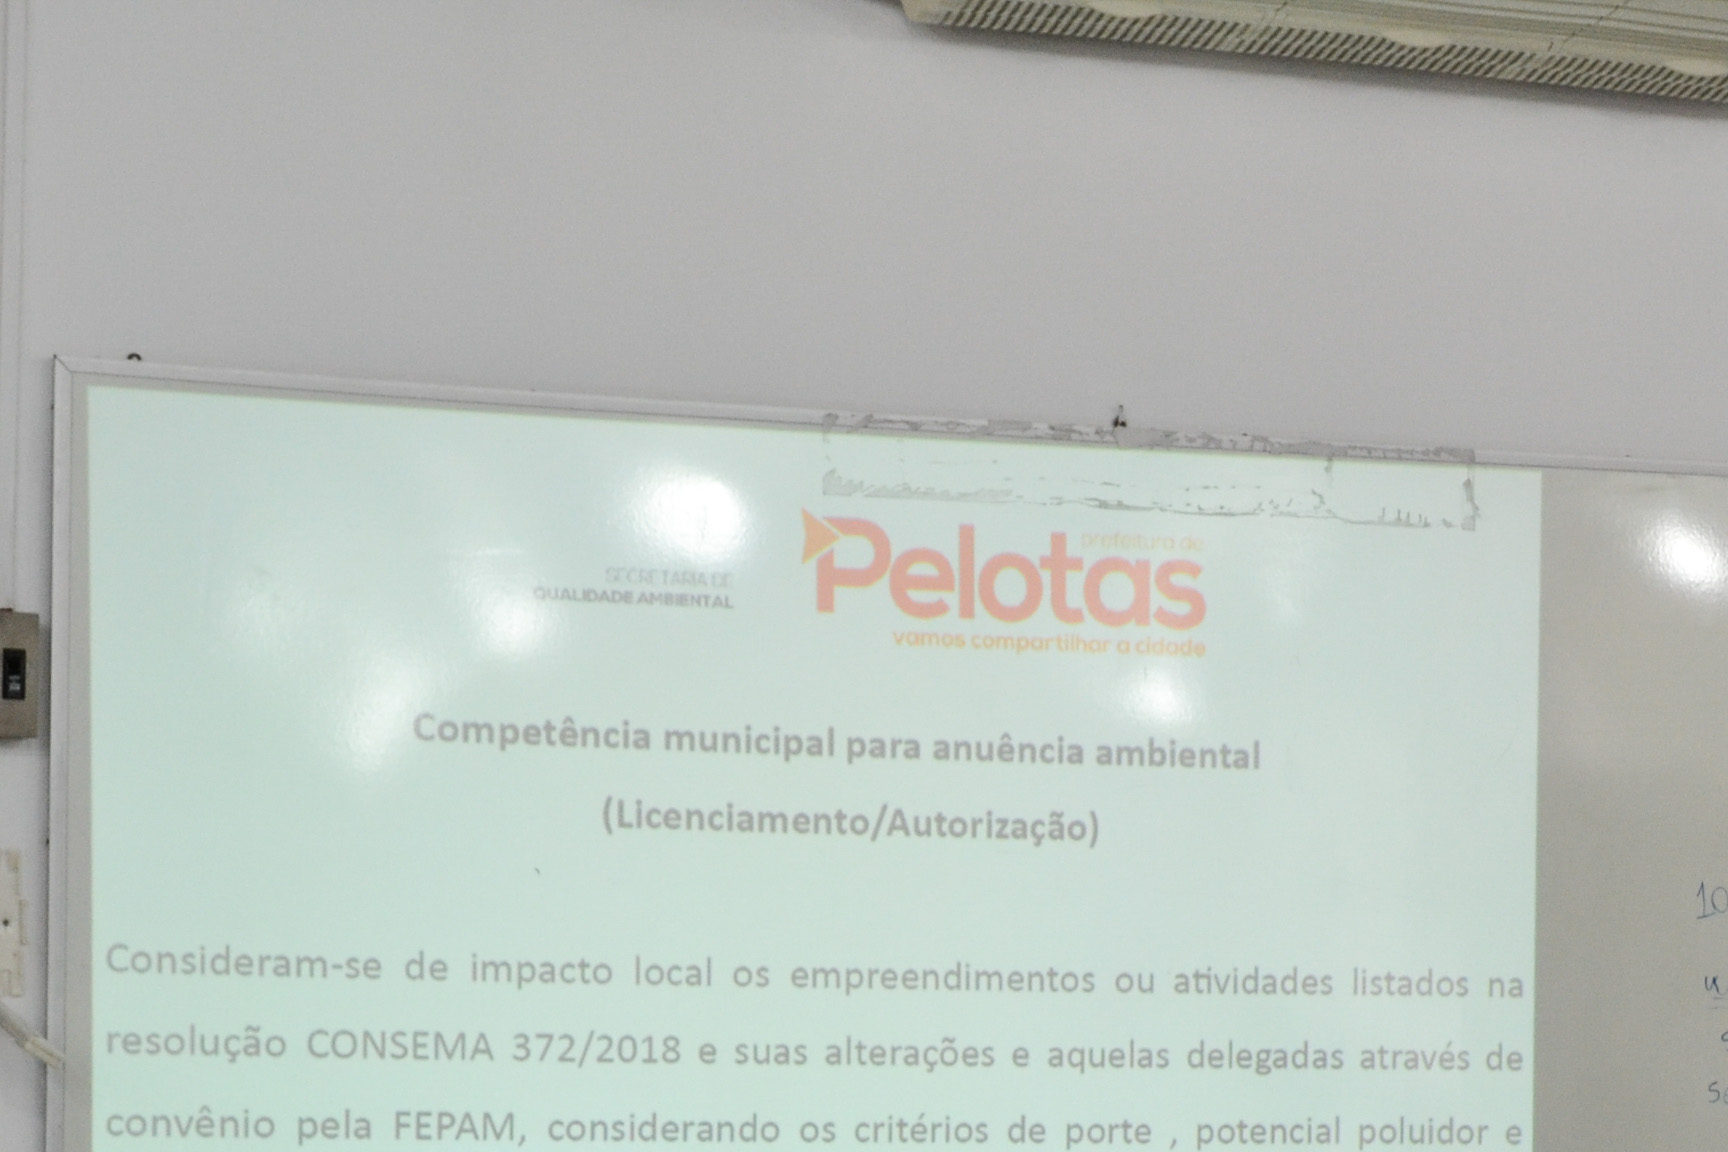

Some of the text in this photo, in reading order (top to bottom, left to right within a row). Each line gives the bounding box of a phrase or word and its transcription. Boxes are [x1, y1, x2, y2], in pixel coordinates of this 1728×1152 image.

[533, 587, 734, 608] QUALIDADE AMBIENTAL
[815, 514, 1208, 630] Pelotas
[892, 631, 1206, 658] vamos compartilhar a cidade
[412, 711, 1261, 771] Competência municipal para anuência ambiental
[601, 795, 1099, 848] (Licenciamento/Autorização)
[106, 942, 1524, 999] Consideram-se de impacto local os empreendimentos ou atividades listados na
[106, 1025, 1524, 1075] resolução CONSEMA 372/2018 e suas alterações e aquelas delegadas através de
[106, 1106, 275, 1139] convênio
[298, 1111, 372, 1145] pela
[395, 1111, 527, 1146] FEPAM,
[548, 1112, 780, 1144] considerando
[799, 1121, 836, 1144] os
[854, 1114, 989, 1144] critérios
[1008, 1114, 1046, 1144] de
[1065, 1119, 1151, 1150] porte
[1196, 1116, 1341, 1150] potencial
[1358, 1118, 1489, 1150] poluidor
[1506, 1124, 1522, 1146] e
